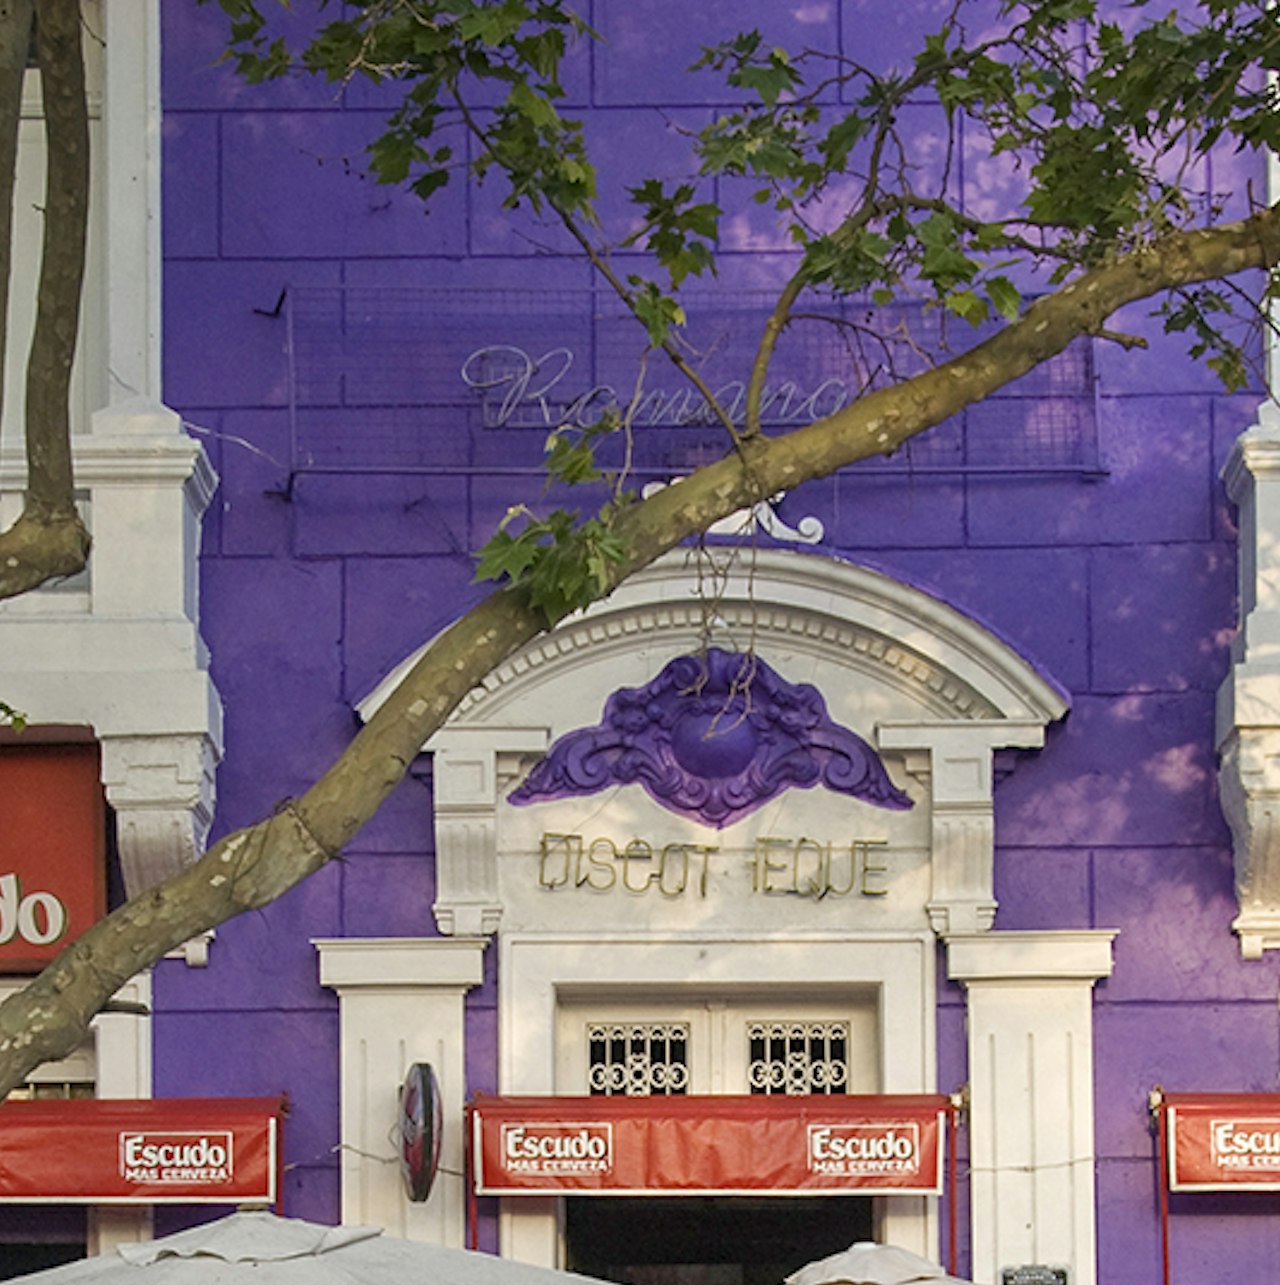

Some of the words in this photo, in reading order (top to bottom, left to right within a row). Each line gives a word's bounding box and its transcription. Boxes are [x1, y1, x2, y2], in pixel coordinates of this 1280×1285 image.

[125, 1135, 226, 1168] Escudo
[506, 1127, 606, 1159] Escudo
[812, 1128, 913, 1160] Escudo
